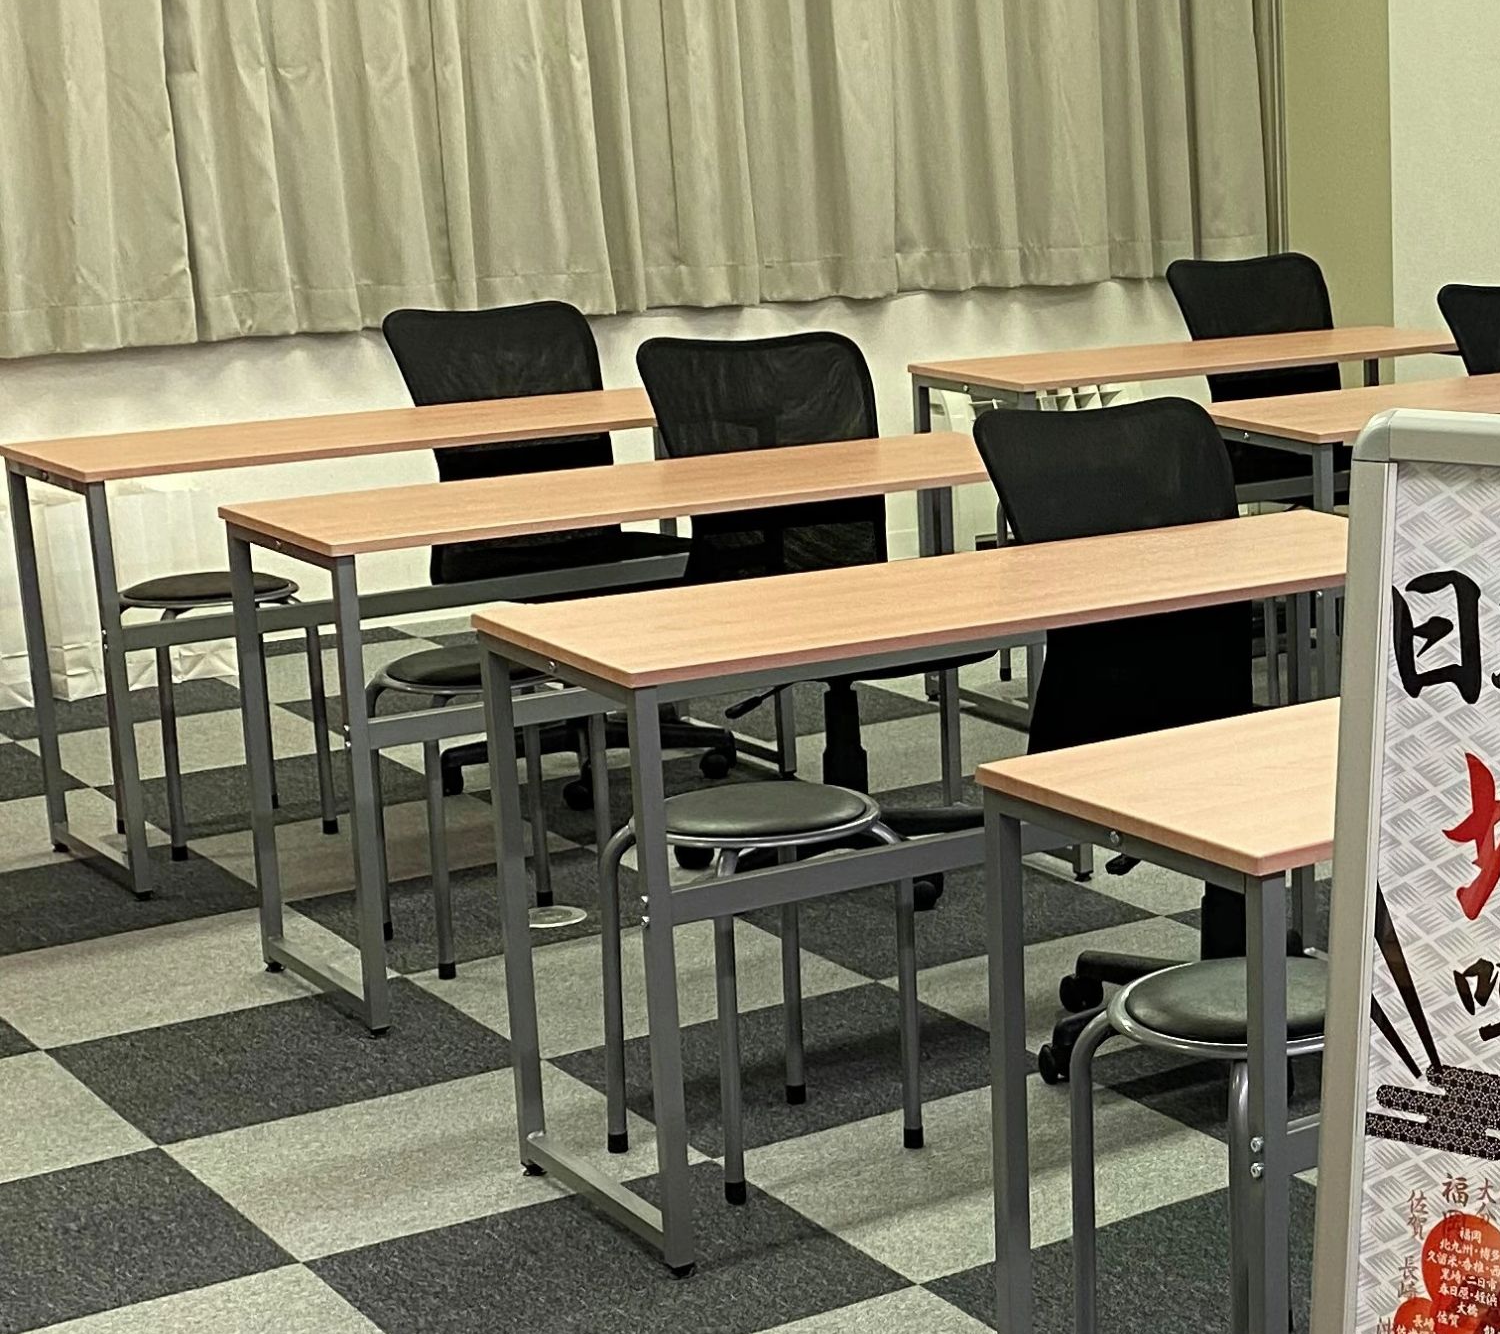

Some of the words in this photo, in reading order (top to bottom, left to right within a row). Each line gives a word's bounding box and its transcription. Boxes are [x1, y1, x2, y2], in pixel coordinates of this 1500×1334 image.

[1406, 1190, 1429, 1240] 佐賀
[1460, 1227, 1482, 1243] 福岡
[1397, 1256, 1419, 1298] 長崎
